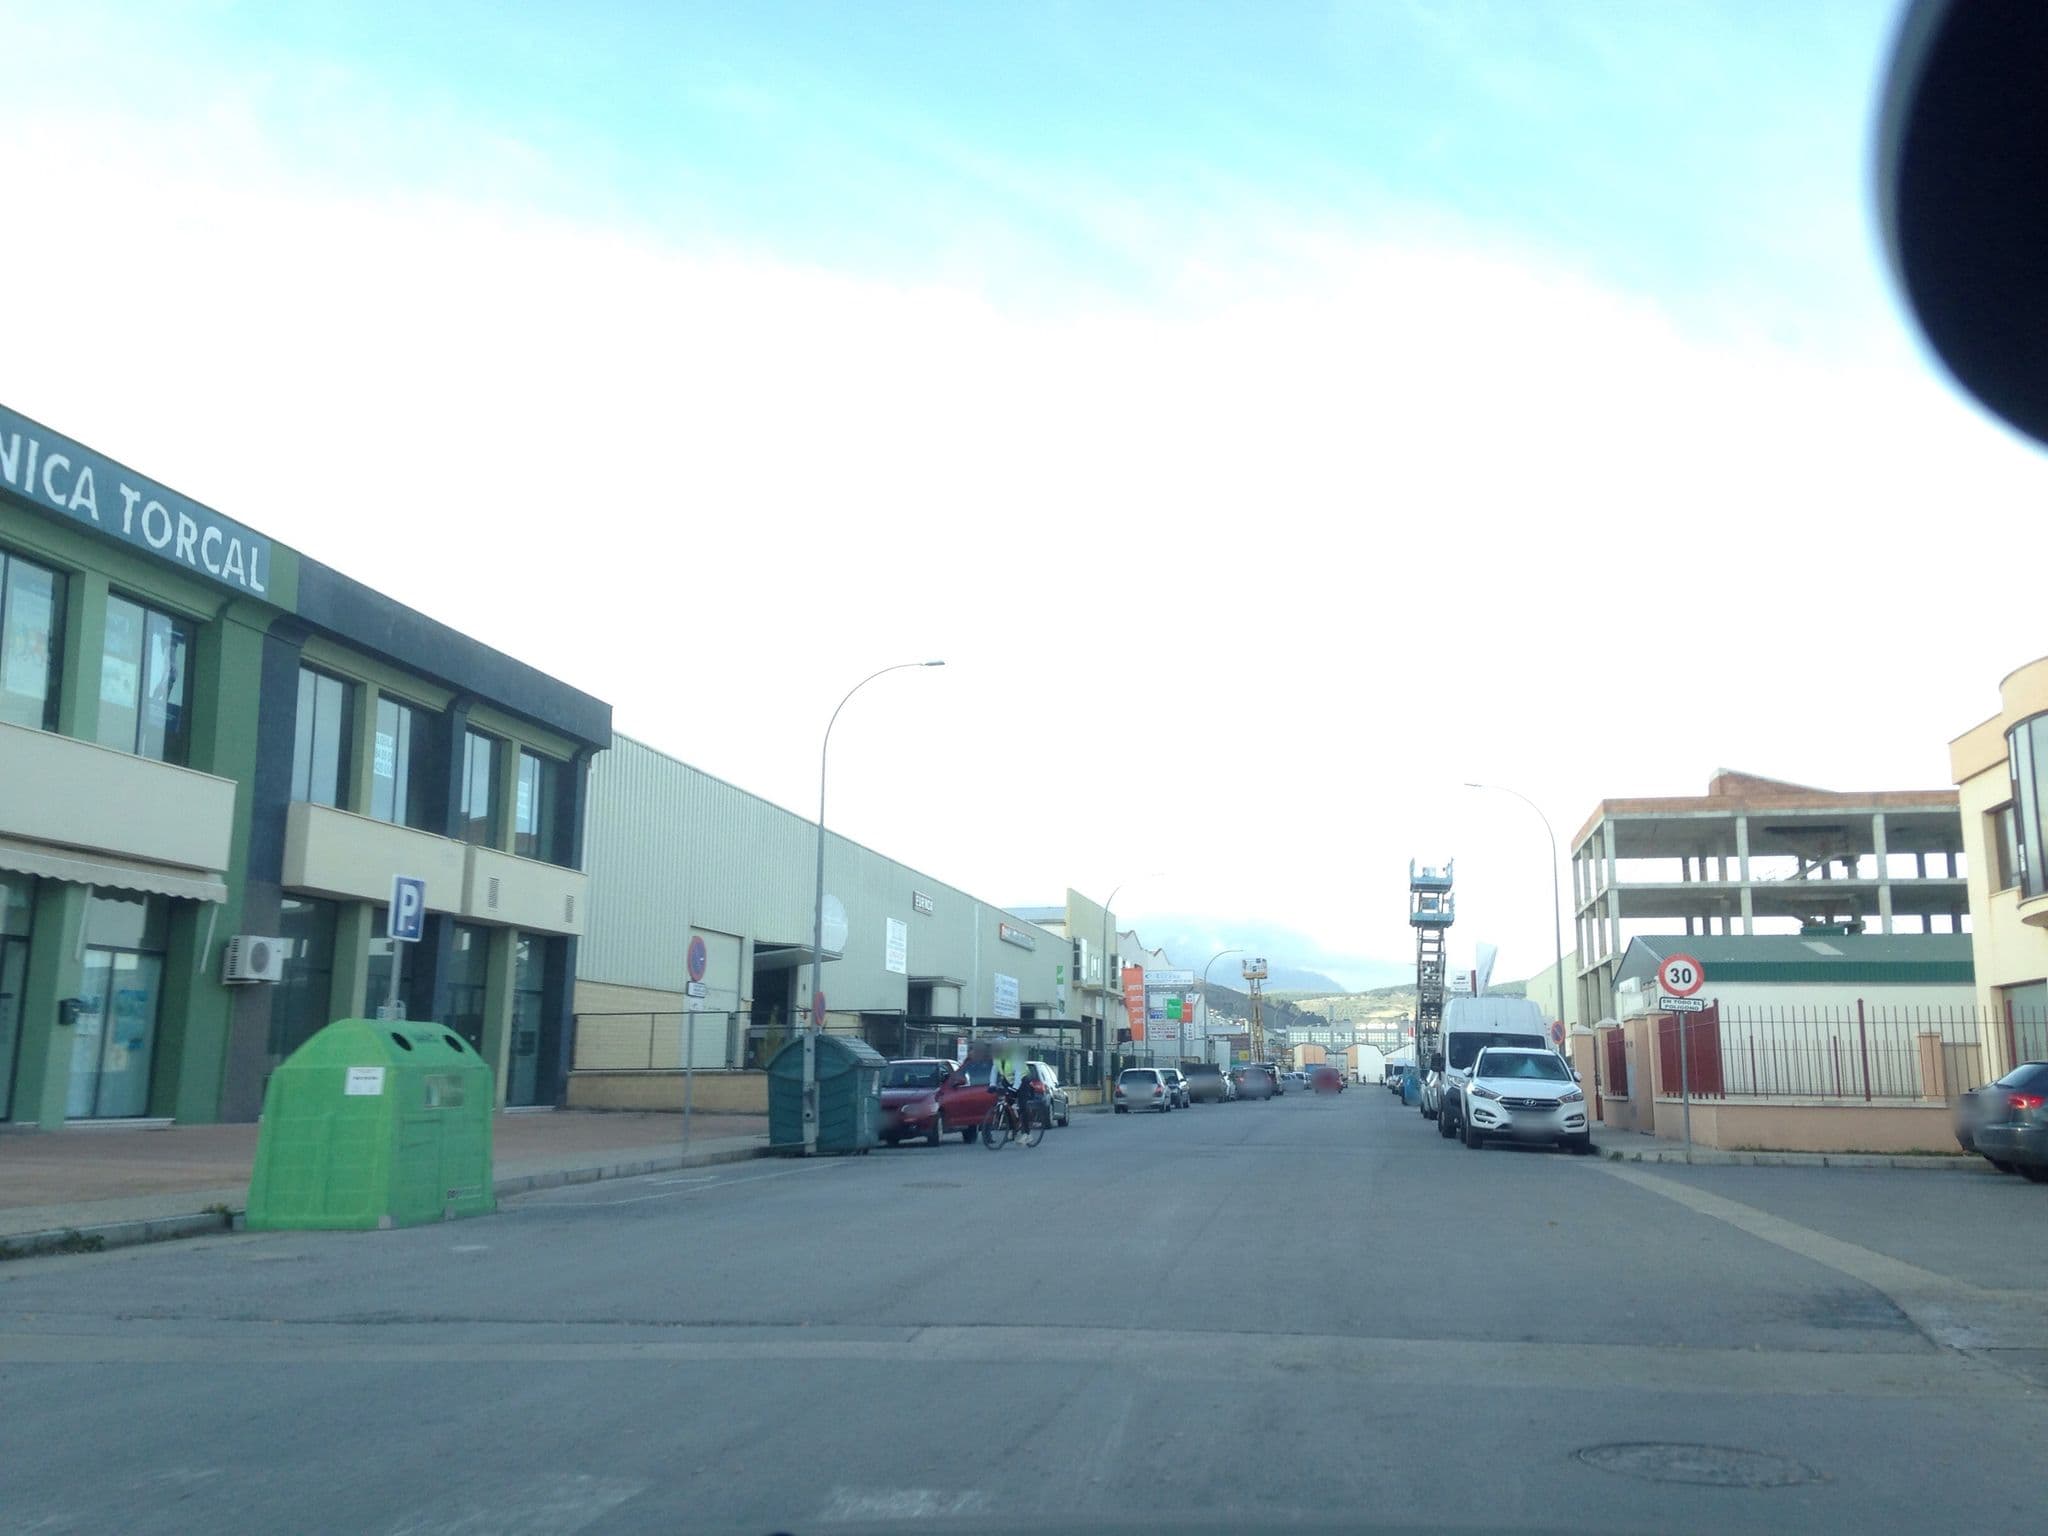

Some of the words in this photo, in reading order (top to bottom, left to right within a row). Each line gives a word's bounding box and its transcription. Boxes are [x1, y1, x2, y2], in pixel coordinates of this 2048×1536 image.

[119, 482, 265, 592] TORCAL
[397, 884, 418, 931] P
[1670, 968, 1691, 983] 30
